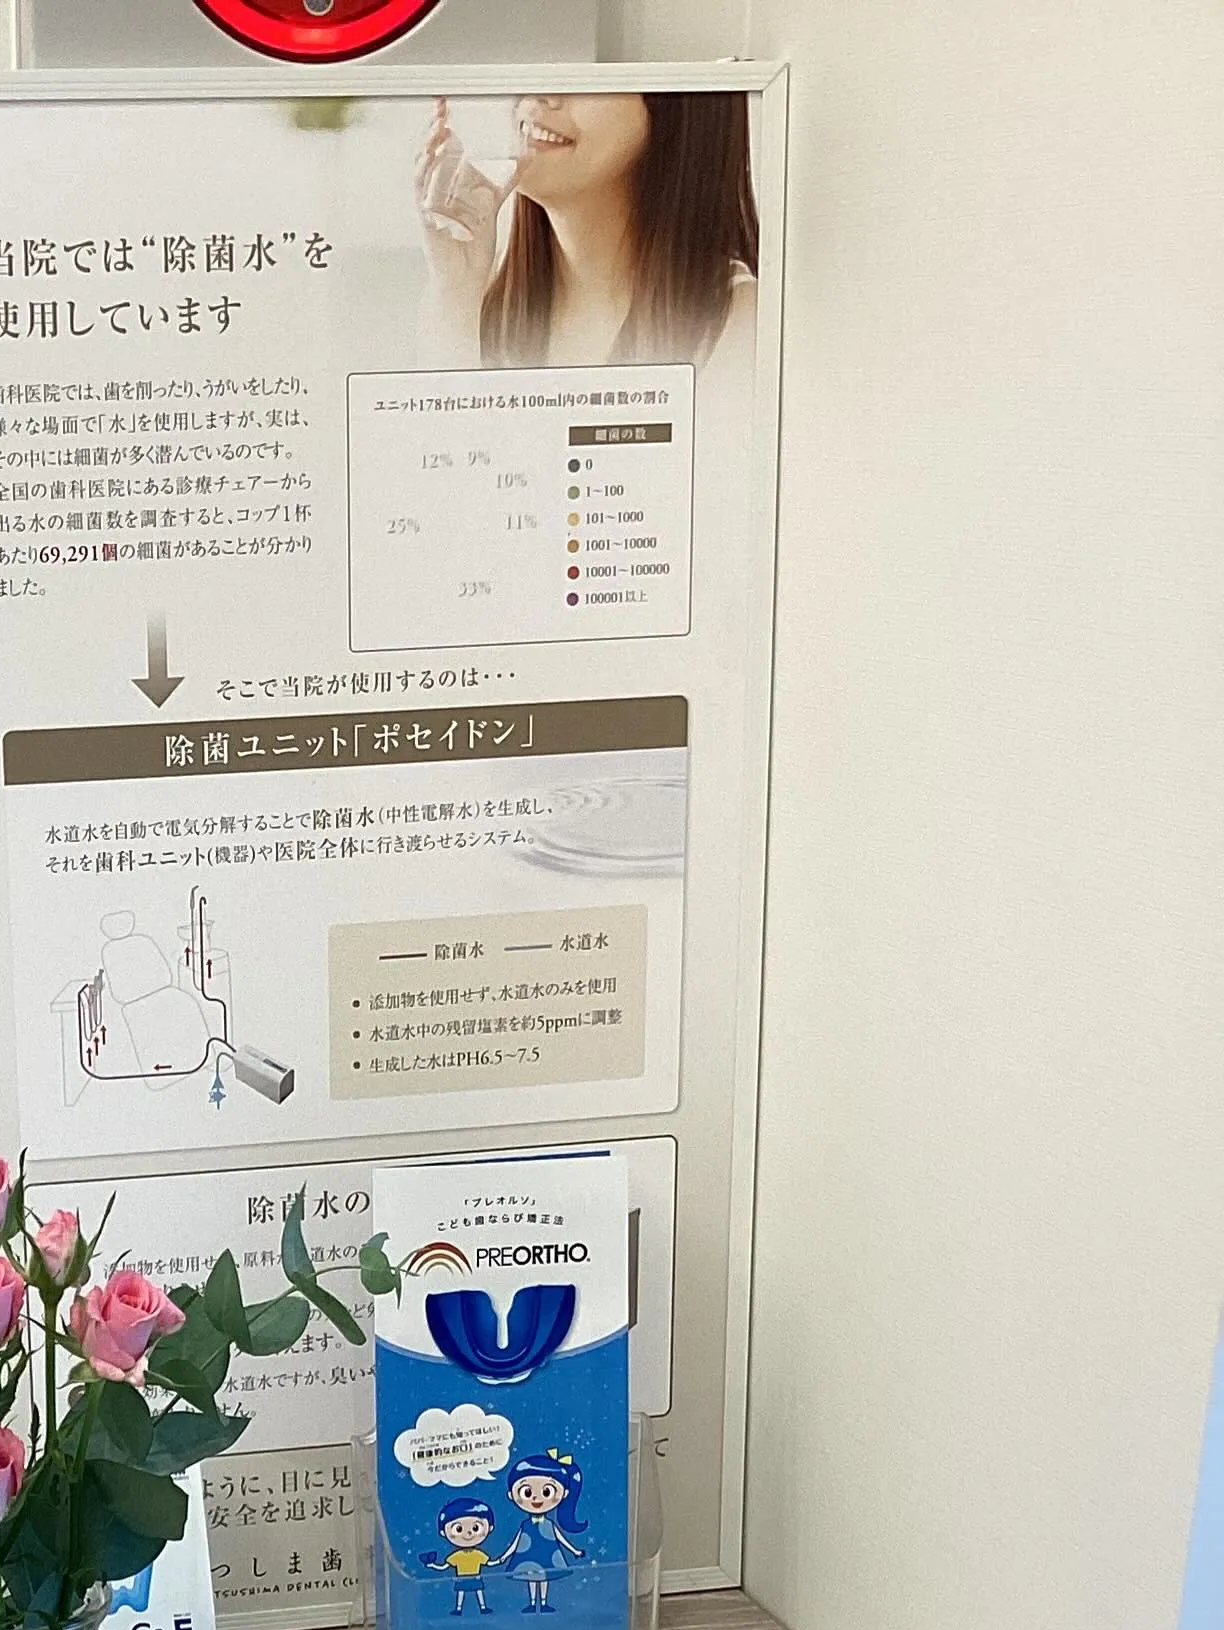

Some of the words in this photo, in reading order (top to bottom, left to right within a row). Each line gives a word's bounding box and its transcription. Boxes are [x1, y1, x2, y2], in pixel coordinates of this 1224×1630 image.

[584, 459, 594, 471] 0
[164, 713, 537, 768] 除菌ユニット「ポセイドン」
[433, 940, 485, 962] 除菌水
[559, 932, 610, 953] 水道水
[368, 976, 618, 1011] 添加物を使用せず、水道水のみを使用
[368, 1008, 623, 1043] 水道水中の残留塩素を約5ppmに調整
[213, 1583, 281, 1600] TSUSHIMA
[286, 1579, 336, 1593] DENTAL
